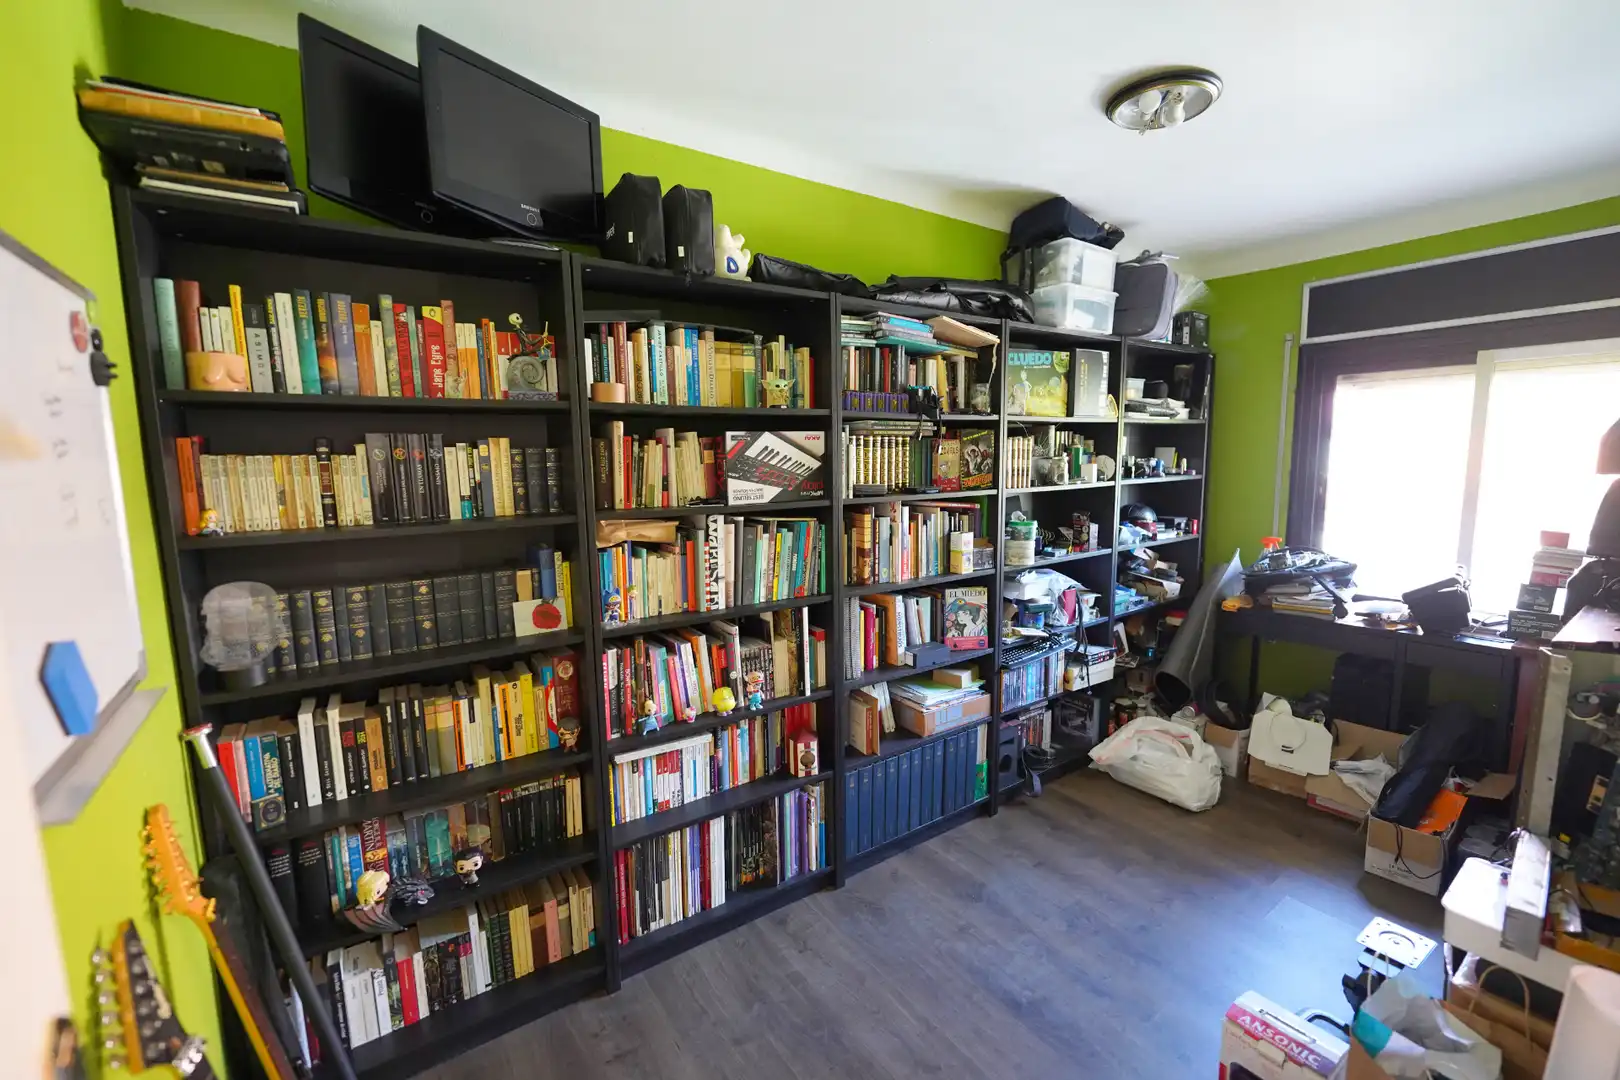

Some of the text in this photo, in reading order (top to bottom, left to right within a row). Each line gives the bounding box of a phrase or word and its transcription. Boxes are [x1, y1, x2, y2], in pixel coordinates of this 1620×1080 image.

[254, 333, 265, 377] ASIMOV
[430, 344, 444, 388] Jane Eyre
[1008, 352, 1052, 366] CLUEDO
[962, 590, 986, 598] MIEDO
[1237, 1015, 1322, 1066] ANSONIC
